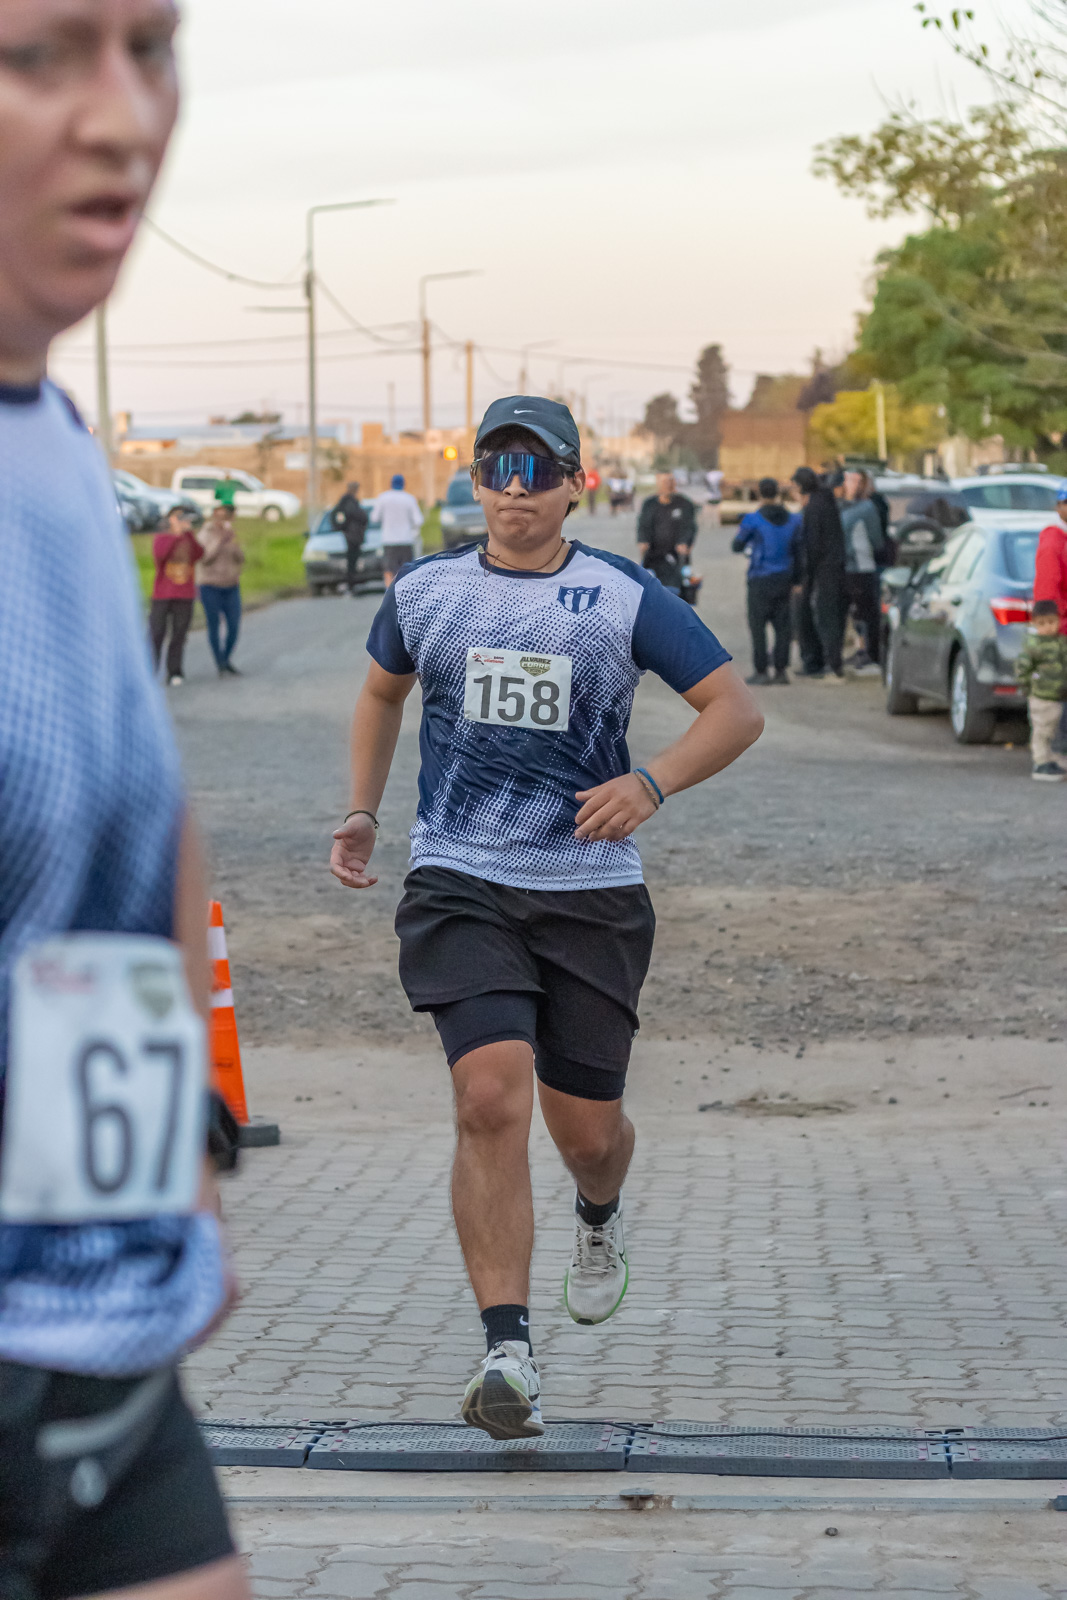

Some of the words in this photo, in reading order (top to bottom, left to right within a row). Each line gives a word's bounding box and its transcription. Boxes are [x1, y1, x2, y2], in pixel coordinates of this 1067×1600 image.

[521, 656, 551, 664] ALVAREZ
[521, 661, 551, 669] CORRE
[473, 674, 560, 726] 158
[77, 1036, 184, 1196] 67
